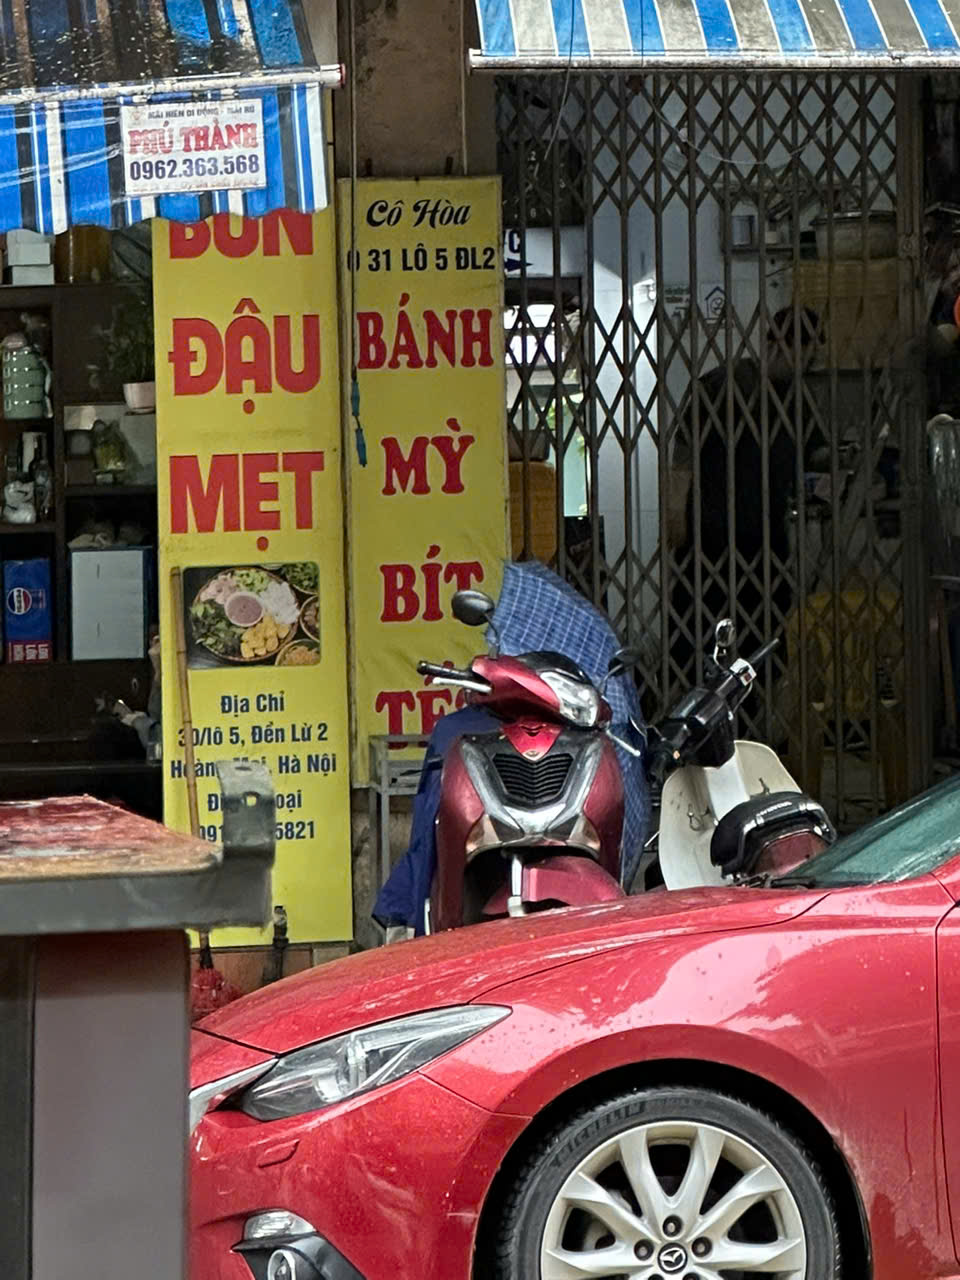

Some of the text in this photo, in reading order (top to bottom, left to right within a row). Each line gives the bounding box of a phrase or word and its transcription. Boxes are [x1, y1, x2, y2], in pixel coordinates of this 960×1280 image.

[128, 117, 259, 155] PHÚ THÀNH
[130, 153, 260, 181] 0962.363.568
[366, 198, 472, 228] Cô Hòa
[368, 249, 392, 271] 31
[402, 242, 428, 271] LÔ
[435, 249, 448, 270] 5
[455, 247, 496, 271] ĐL2
[356, 292, 495, 370] BÁNH
[168, 298, 321, 414] ĐẬU
[380, 417, 476, 496] MỲ
[169, 451, 325, 552] MẸT
[380, 544, 485, 623] BÍT
[221, 691, 285, 718] Địa Chỉ
[229, 726, 246, 747] 5,
[251, 721, 285, 744] Đền
[291, 723, 313, 742] Lừ
[317, 722, 329, 741] 2
[278, 754, 301, 774] Hà
[307, 752, 337, 777] Nội
